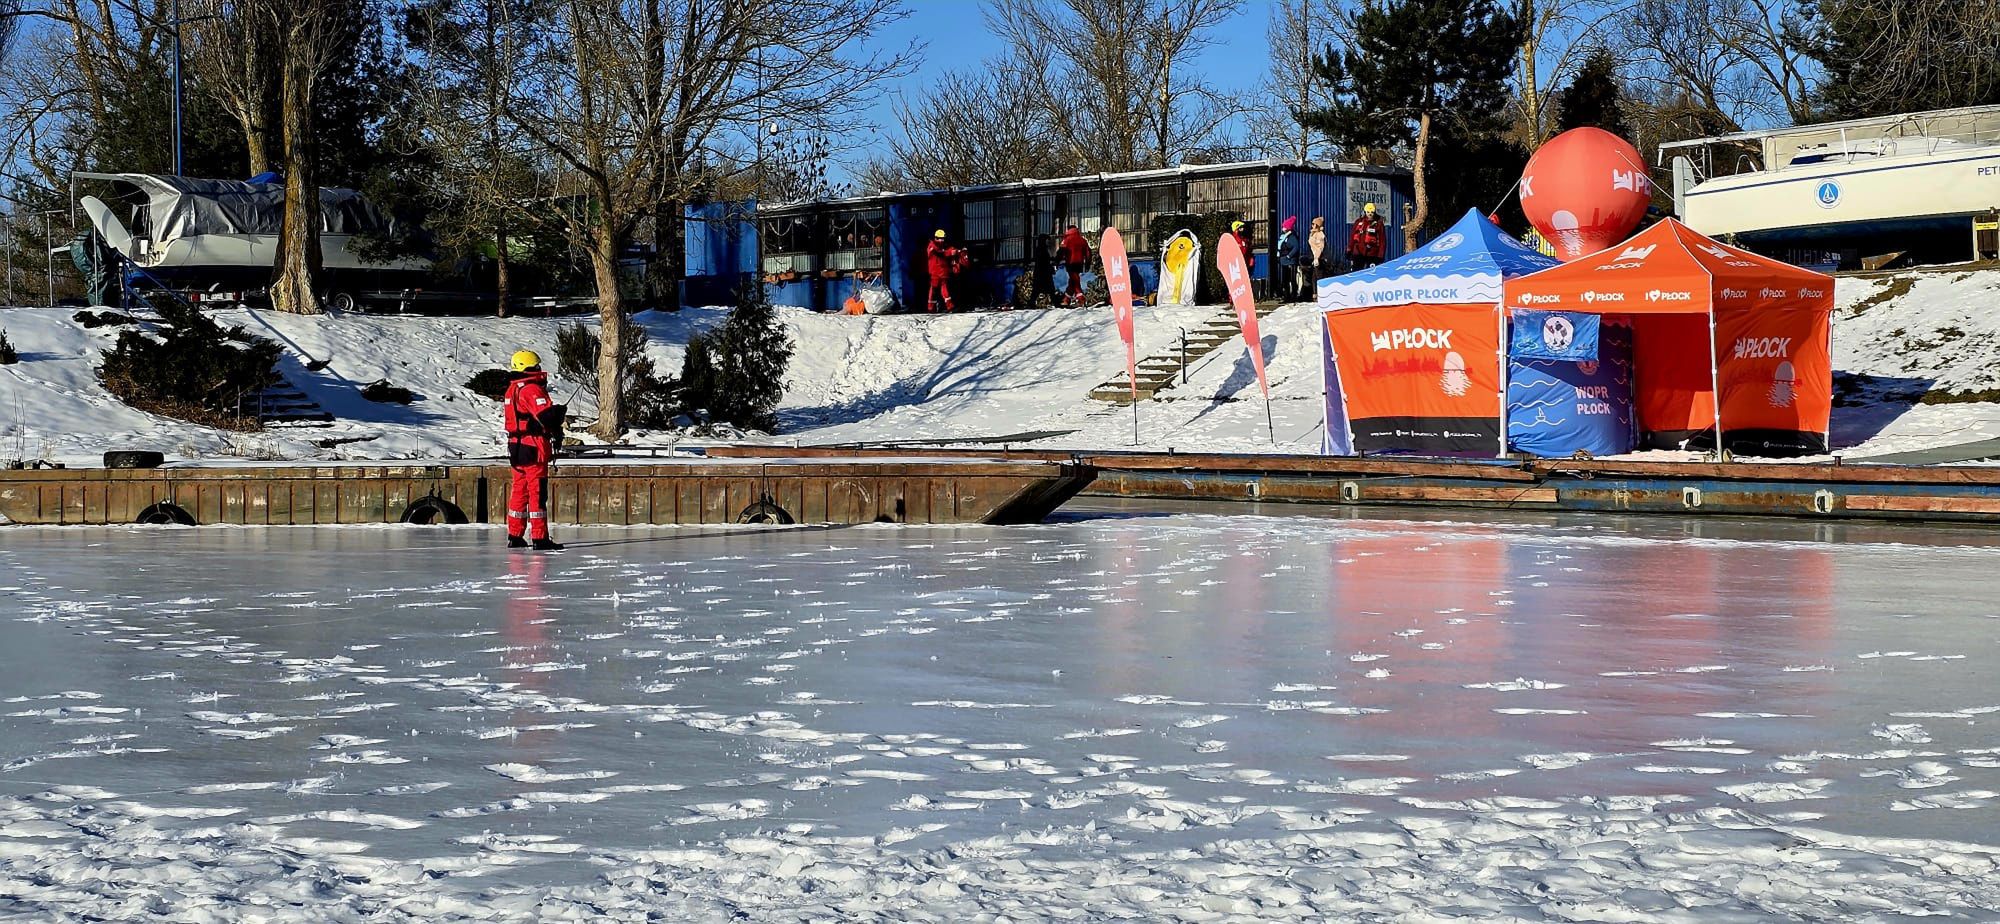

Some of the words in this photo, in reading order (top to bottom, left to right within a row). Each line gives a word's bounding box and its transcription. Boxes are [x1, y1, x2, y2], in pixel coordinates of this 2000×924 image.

[1977, 166, 2000, 176] PET
[1360, 180, 1378, 192] KLUB
[1406, 255, 1452, 264] WOPR
[1373, 289, 1413, 303] WOPR
[1417, 288, 1458, 299] PŁOCK
[1533, 294, 1561, 304] PŁOCK
[1596, 292, 1625, 302] PŁOCK
[1661, 291, 1692, 300] PŁOCK
[1391, 327, 1453, 350] PŁOCK
[1743, 336, 1792, 359] PŁOCK
[1575, 385, 1609, 399] WOPR
[1576, 402, 1611, 415] PŁOCK
